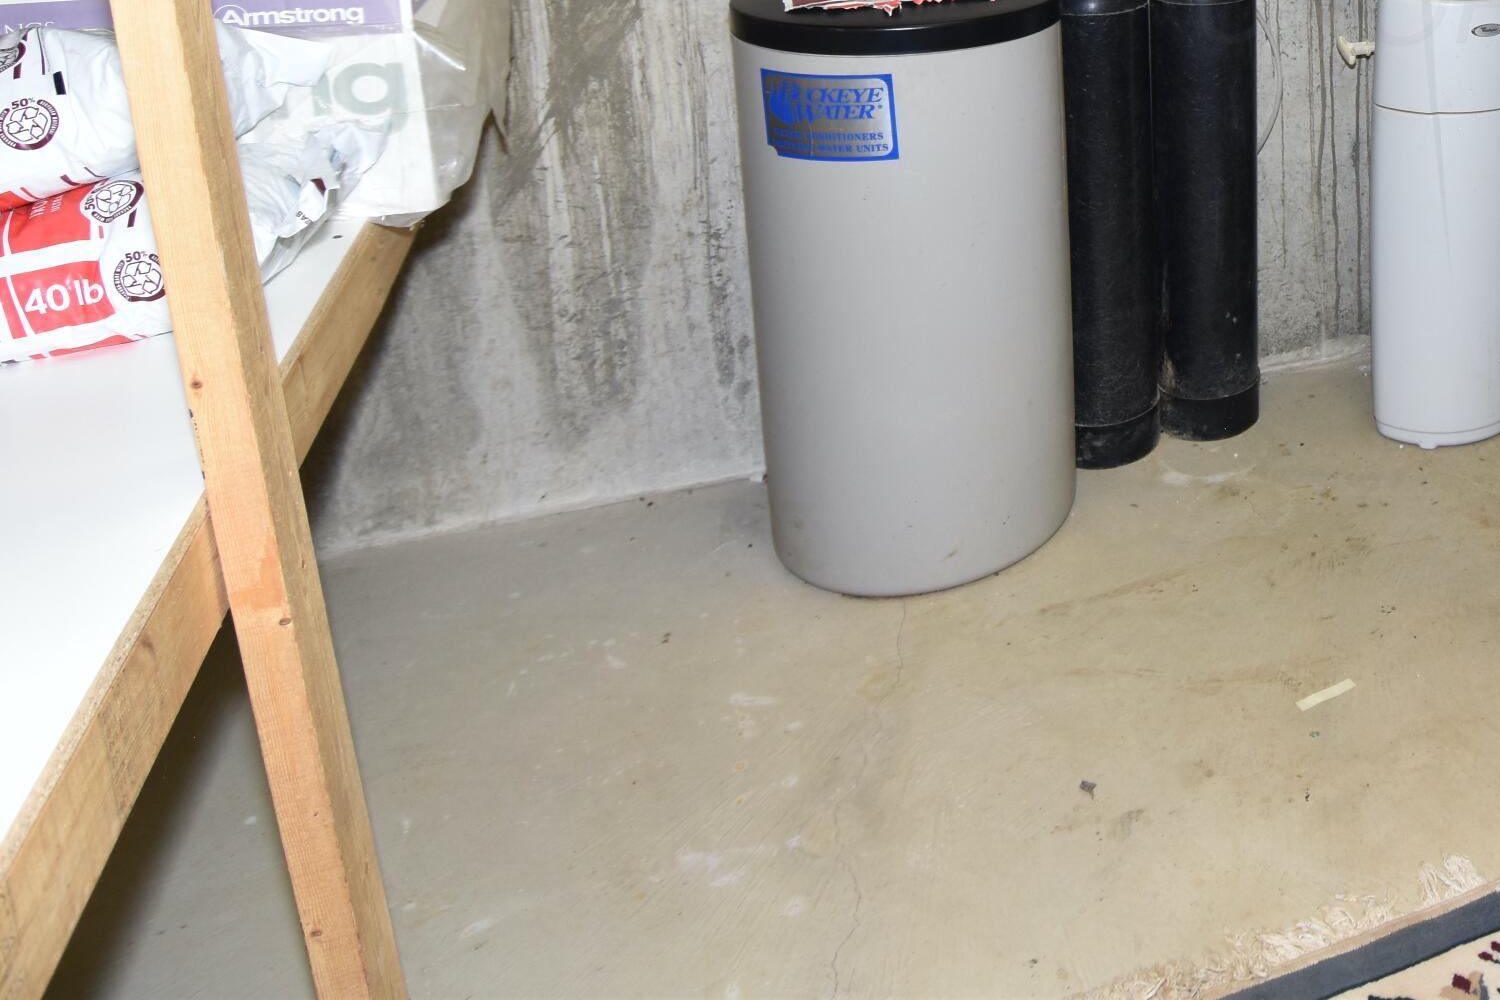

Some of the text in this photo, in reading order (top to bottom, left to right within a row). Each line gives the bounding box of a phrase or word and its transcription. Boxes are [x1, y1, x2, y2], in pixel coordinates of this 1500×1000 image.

[220, 4, 364, 26] Armstrong
[855, 143, 890, 153] UNITS
[24, 279, 105, 314] 40 lb
